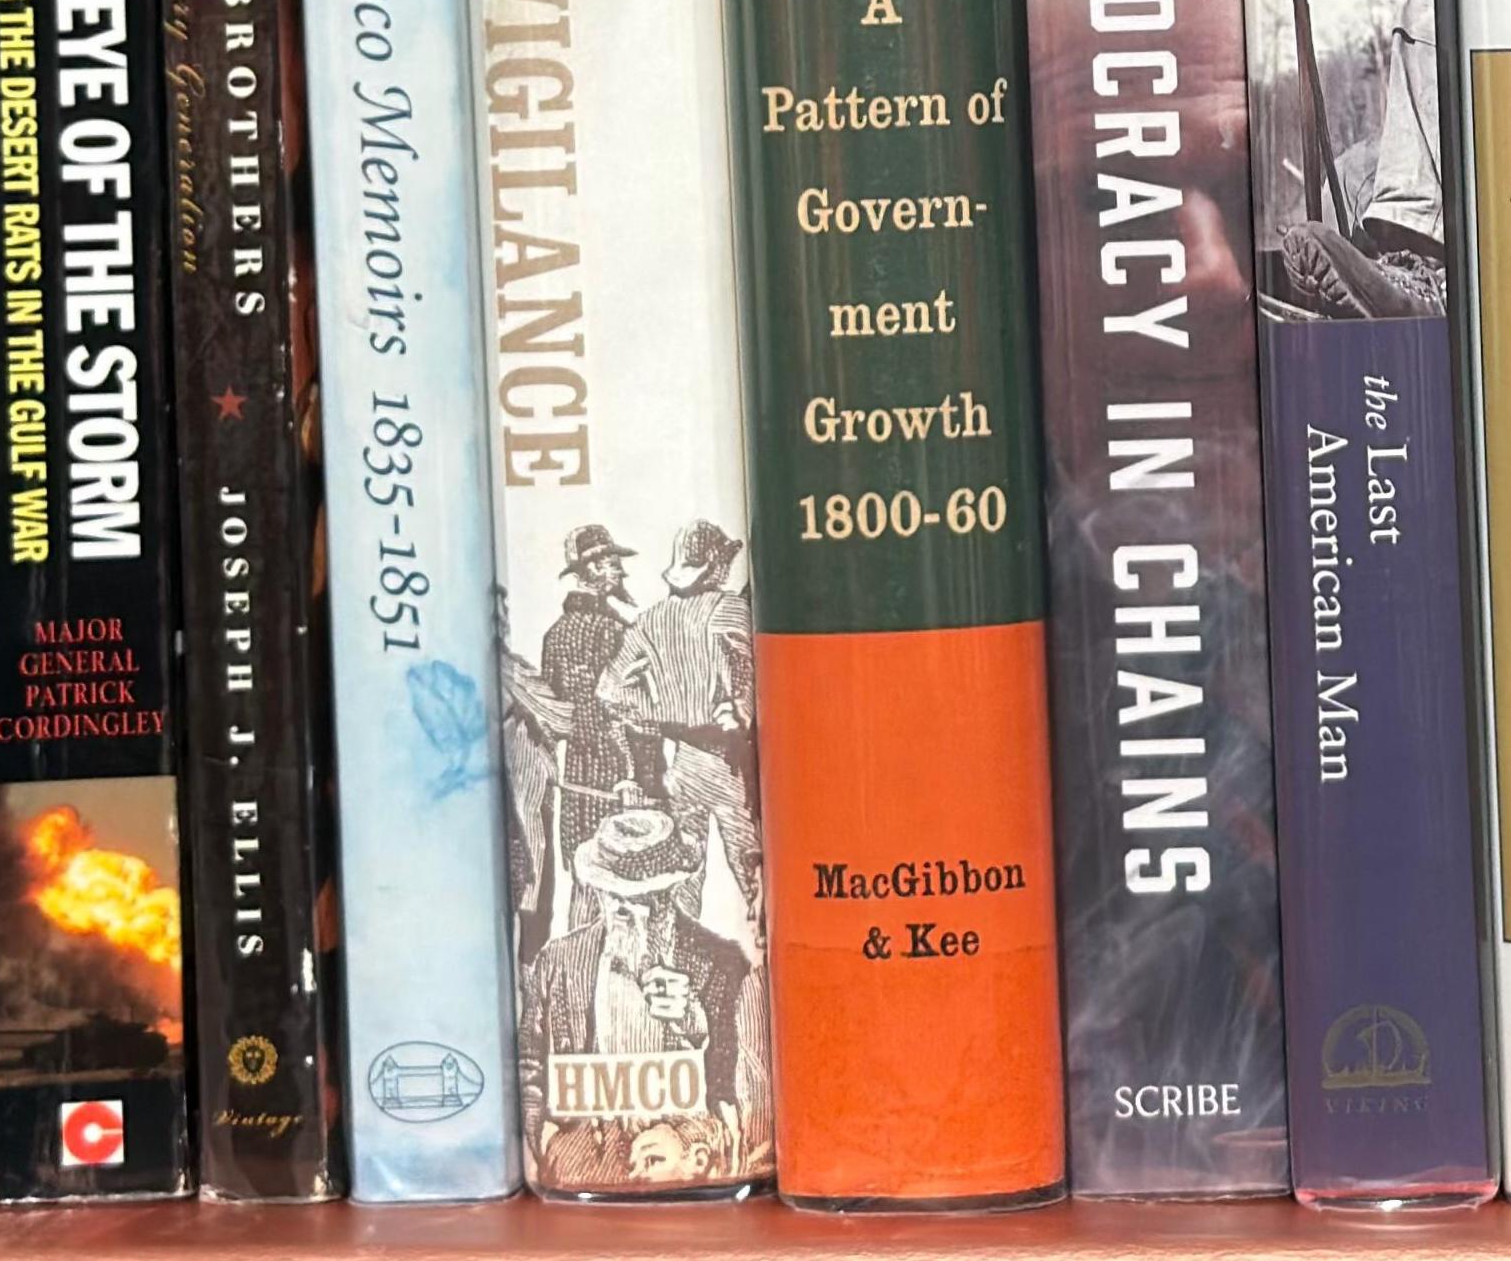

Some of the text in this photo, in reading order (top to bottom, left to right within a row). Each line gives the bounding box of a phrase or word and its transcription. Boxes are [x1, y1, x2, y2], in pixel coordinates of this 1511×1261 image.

[761, 77, 1009, 134] Pattern of
[59, 118, 133, 200] OF
[352, 80, 423, 357] Memoirs
[796, 186, 989, 235] Govern-
[62, 210, 137, 333] THE
[829, 288, 957, 339] ment
[803, 391, 993, 445] Growth
[1106, 401, 1196, 491] IN
[66, 344, 142, 561] STORM
[1363, 373, 1409, 546] the Last
[362, 390, 430, 653] 1835-1851
[798, 484, 1008, 542] 1800-60
[34, 616, 124, 645] MAJOR
[1306, 423, 1360, 785] American Man
[18, 647, 141, 678] GENERAL
[25, 679, 136, 710] PATRICK
[1111, 542, 1212, 896] CHAINS
[553, 1056, 703, 1113] HMCO
[1114, 1082, 1242, 1119] SCRIBE
